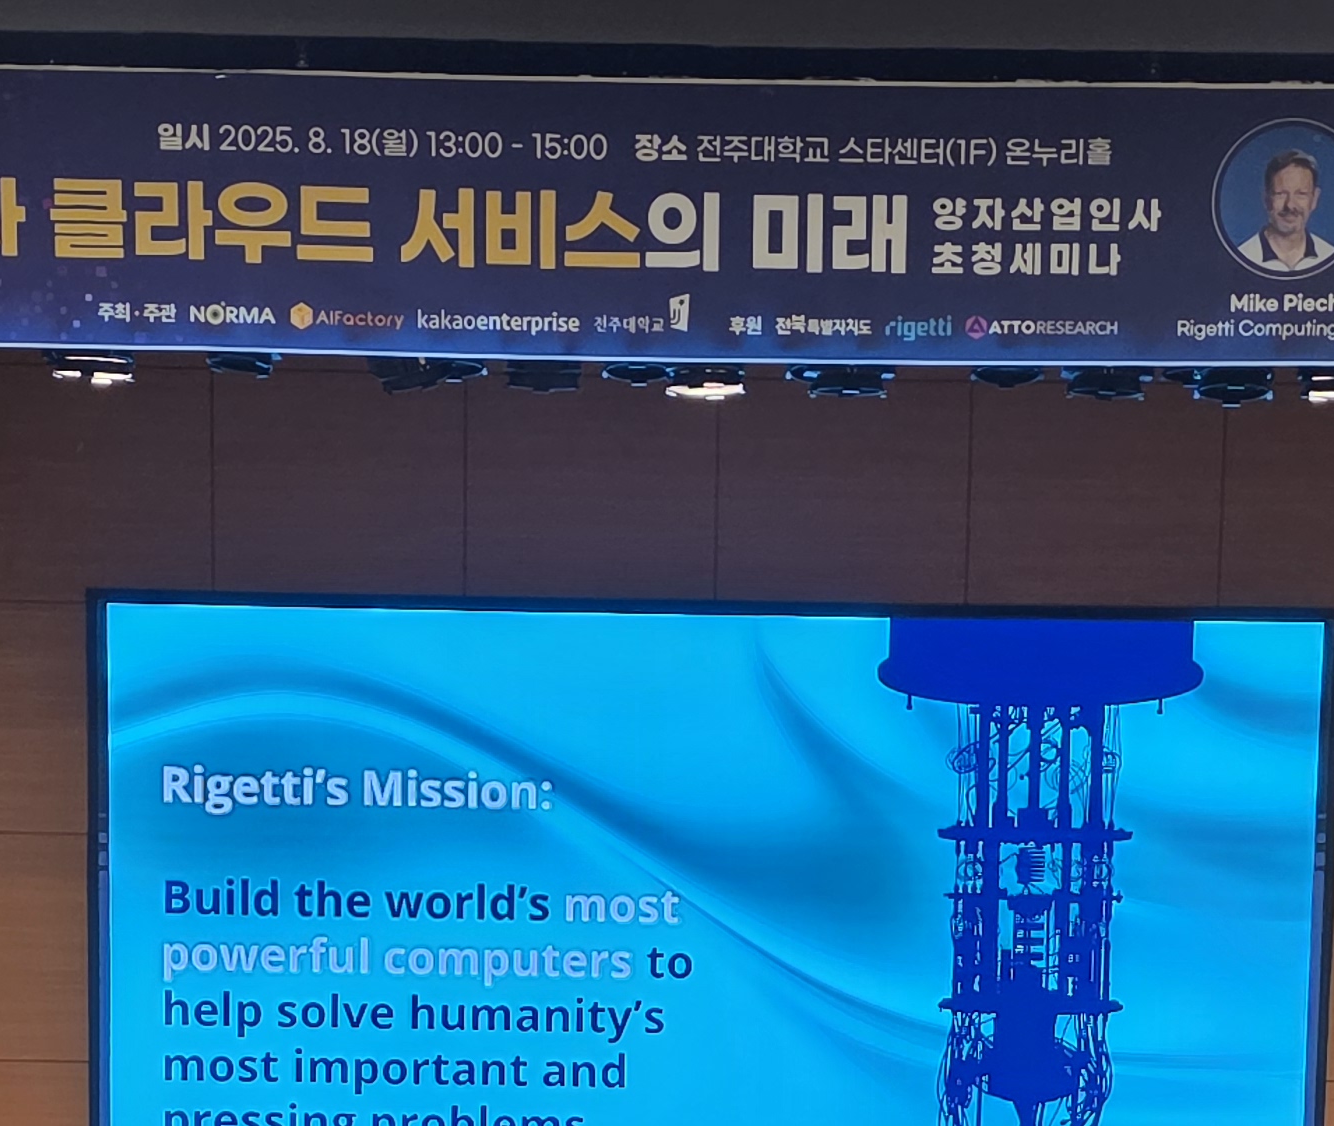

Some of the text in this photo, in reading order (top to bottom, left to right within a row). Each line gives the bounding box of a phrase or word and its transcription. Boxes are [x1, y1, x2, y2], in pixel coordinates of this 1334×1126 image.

[157, 123, 211, 151] 일시
[218, 124, 300, 154] 2025.
[308, 126, 333, 155] 8.
[340, 128, 419, 158] 18(월)
[425, 130, 503, 159] 13:00
[531, 132, 608, 161] 15:00
[634, 133, 688, 162] 장소
[696, 135, 830, 165] 전주대학교
[838, 136, 997, 167] 스타센터(1F)
[1005, 138, 1113, 167] 온누리홀
[49, 177, 375, 264] 클라우드
[400, 187, 721, 274] 서비스의
[752, 192, 909, 275] 미래
[931, 197, 1163, 233] 양자산업인사
[931, 242, 1123, 277] 초청세미나
[189, 301, 277, 326] NORMA
[315, 309, 405, 331] AIFactory
[1230, 293, 1279, 313] Mike
[417, 308, 581, 337] kakaoenterprise
[728, 315, 763, 337] 후원
[884, 314, 953, 342] rigetti
[988, 319, 1120, 337] ATTORESEARCH
[1177, 319, 1235, 341] Rigetti
[162, 764, 554, 815] Rigetti's Mission:
[163, 877, 681, 924] Build the world's most
[162, 936, 693, 986] powerful computers to
[163, 990, 666, 1043] help solve humanity's
[163, 1047, 626, 1094] most important and
